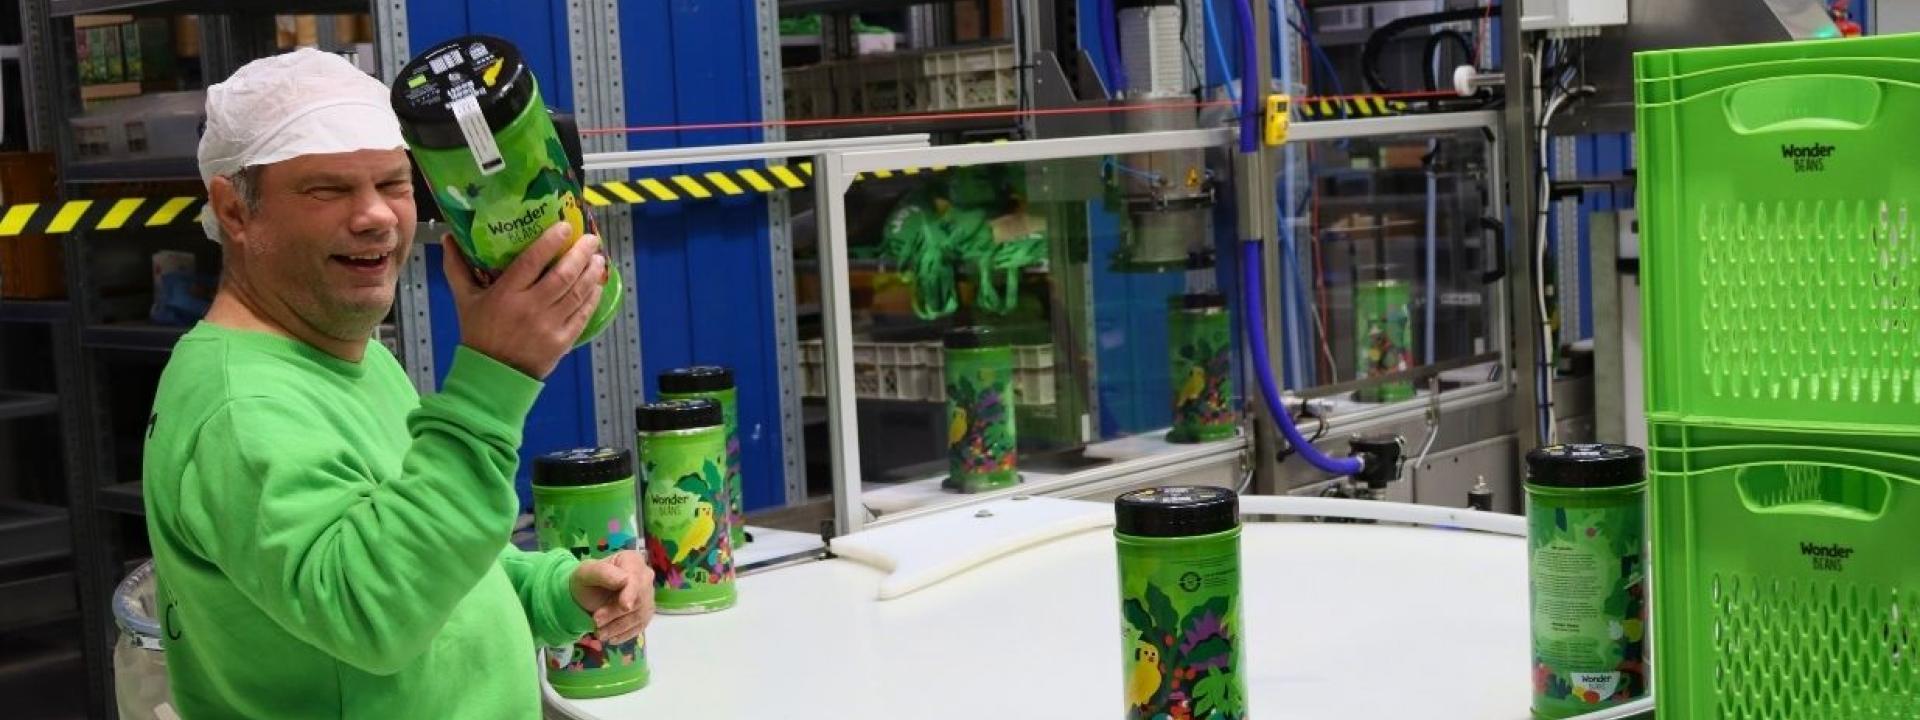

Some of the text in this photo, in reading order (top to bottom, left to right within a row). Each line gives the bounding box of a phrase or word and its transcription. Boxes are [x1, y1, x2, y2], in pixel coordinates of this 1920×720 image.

[1781, 142, 1836, 158] Wonder
[1793, 158, 1824, 172] BEANS
[487, 202, 548, 235] Wonder
[650, 493, 688, 505] Wonder
[1800, 542, 1854, 558] Wonder
[1813, 557, 1843, 572] BEANS
[1581, 674, 1612, 683] Wonder
